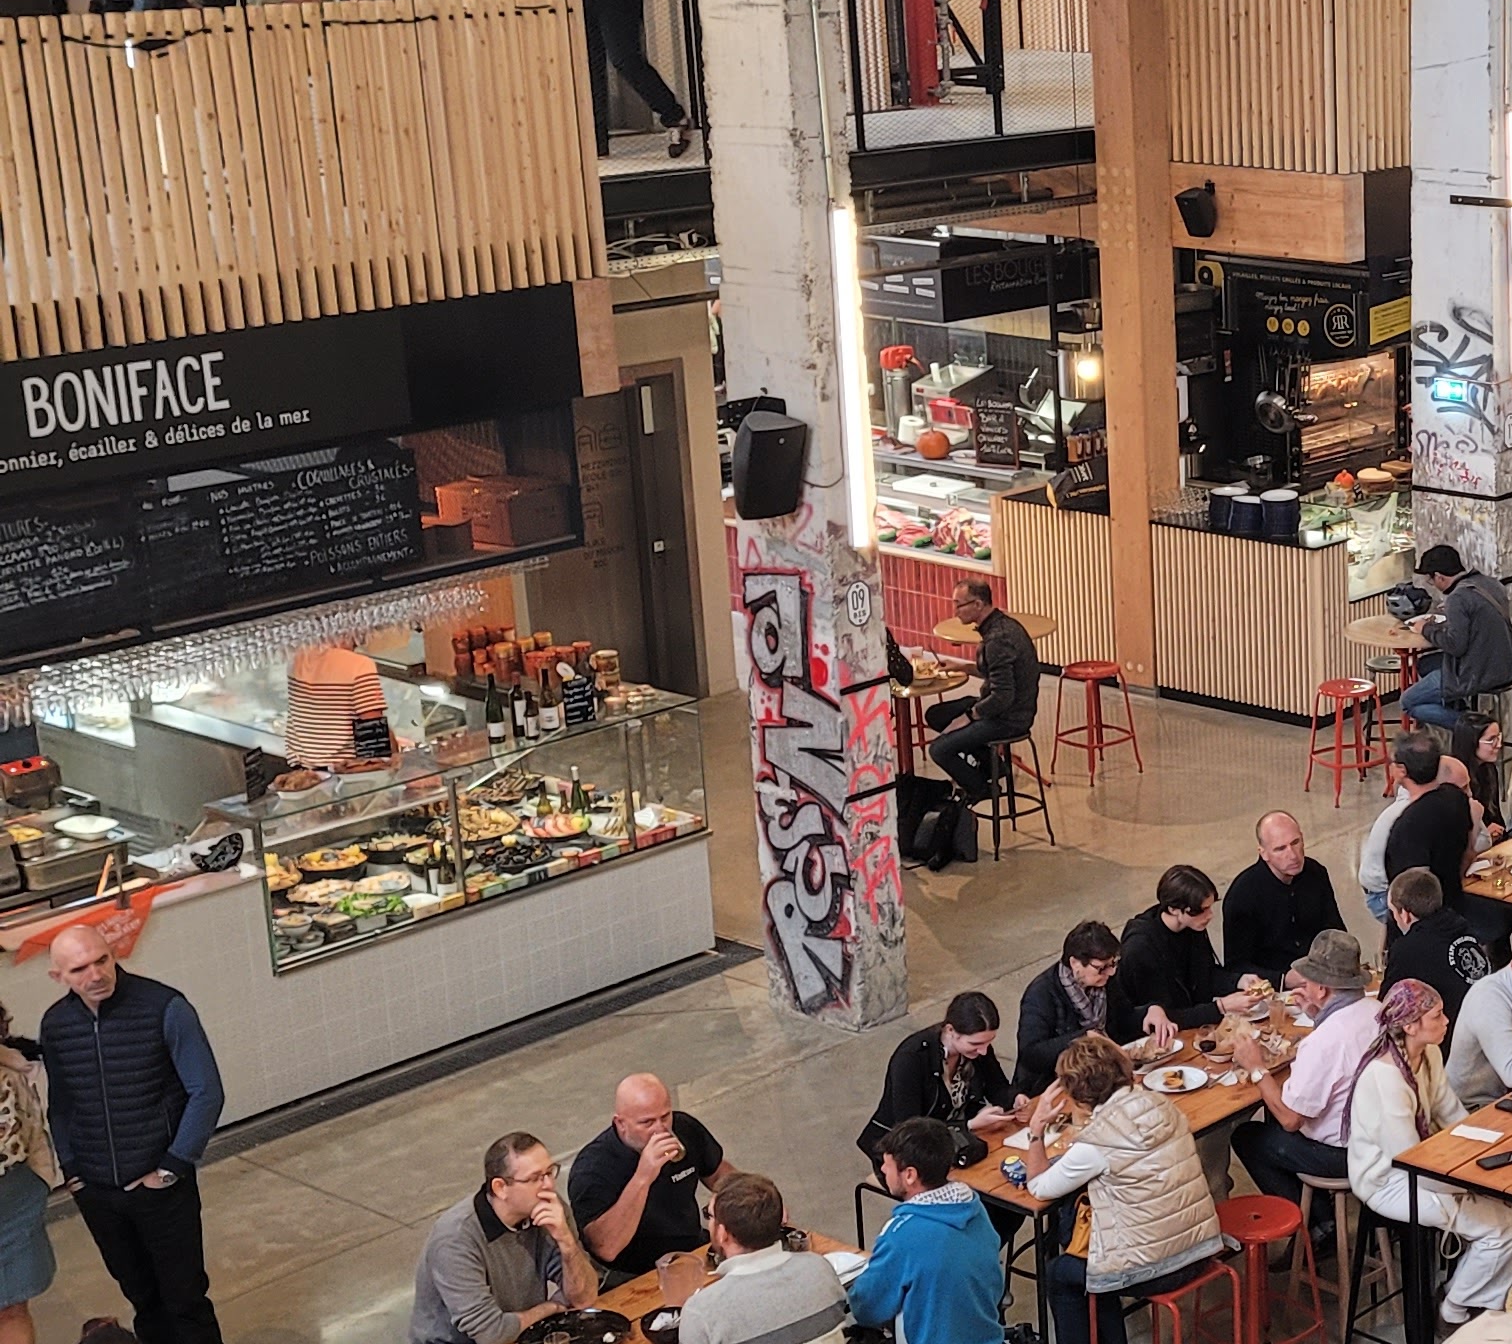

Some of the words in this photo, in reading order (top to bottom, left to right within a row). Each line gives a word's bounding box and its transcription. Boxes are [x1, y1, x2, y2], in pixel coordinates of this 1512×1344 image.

[21, 351, 231, 439] BONIFACE
[68, 435, 138, 462] écailler
[145, 430, 159, 449] &
[165, 420, 226, 446] délices
[231, 415, 251, 434] de
[255, 411, 274, 430] la
[279, 408, 311, 425] mer
[851, 588, 866, 612] 09
